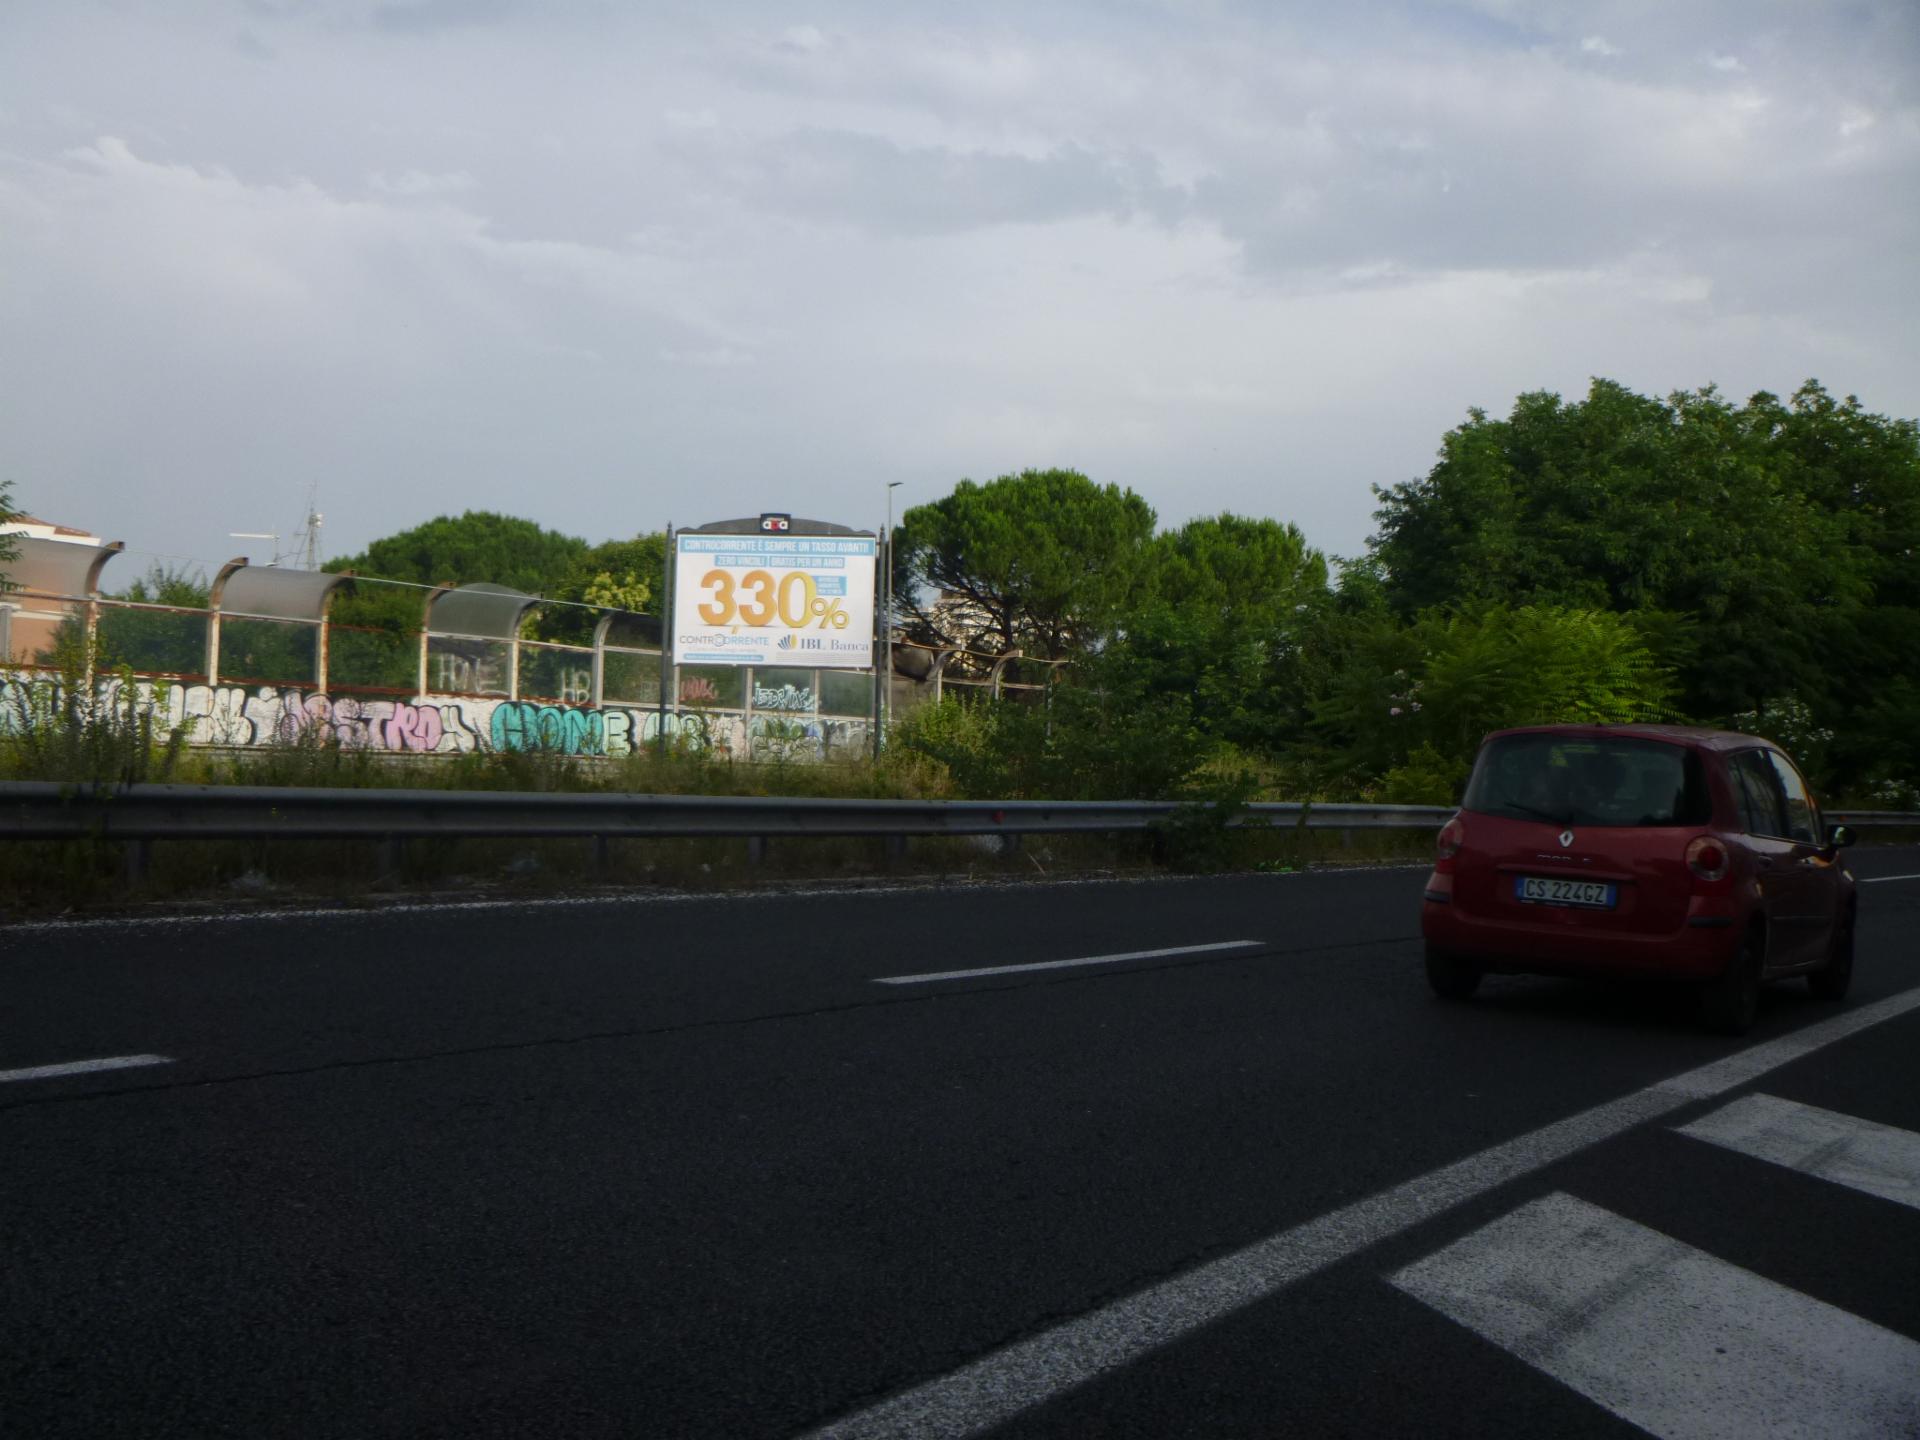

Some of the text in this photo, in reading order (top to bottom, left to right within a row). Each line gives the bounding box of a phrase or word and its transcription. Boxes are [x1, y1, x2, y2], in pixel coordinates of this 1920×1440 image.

[801, 638, 869, 652] IBL Banca
[1551, 881, 1605, 903] 224GZ
